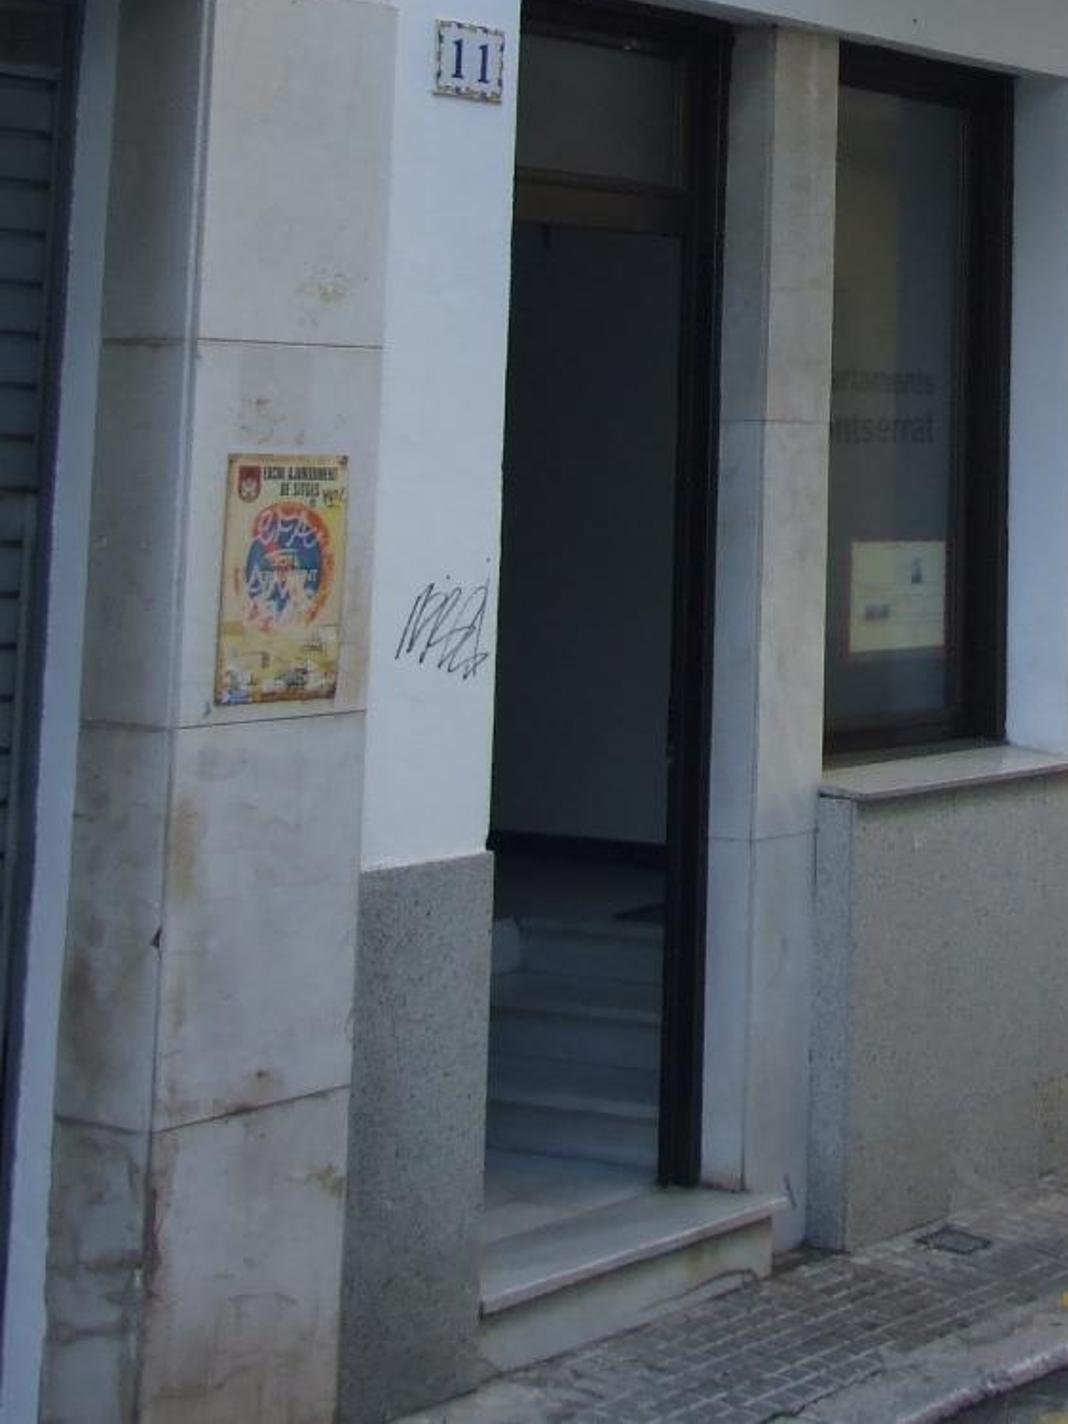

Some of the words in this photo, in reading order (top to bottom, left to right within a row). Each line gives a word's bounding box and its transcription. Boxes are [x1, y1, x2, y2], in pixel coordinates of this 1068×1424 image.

[451, 38, 490, 84] 11
[831, 412, 934, 444] ntserrat
[280, 482, 289, 496] DE
